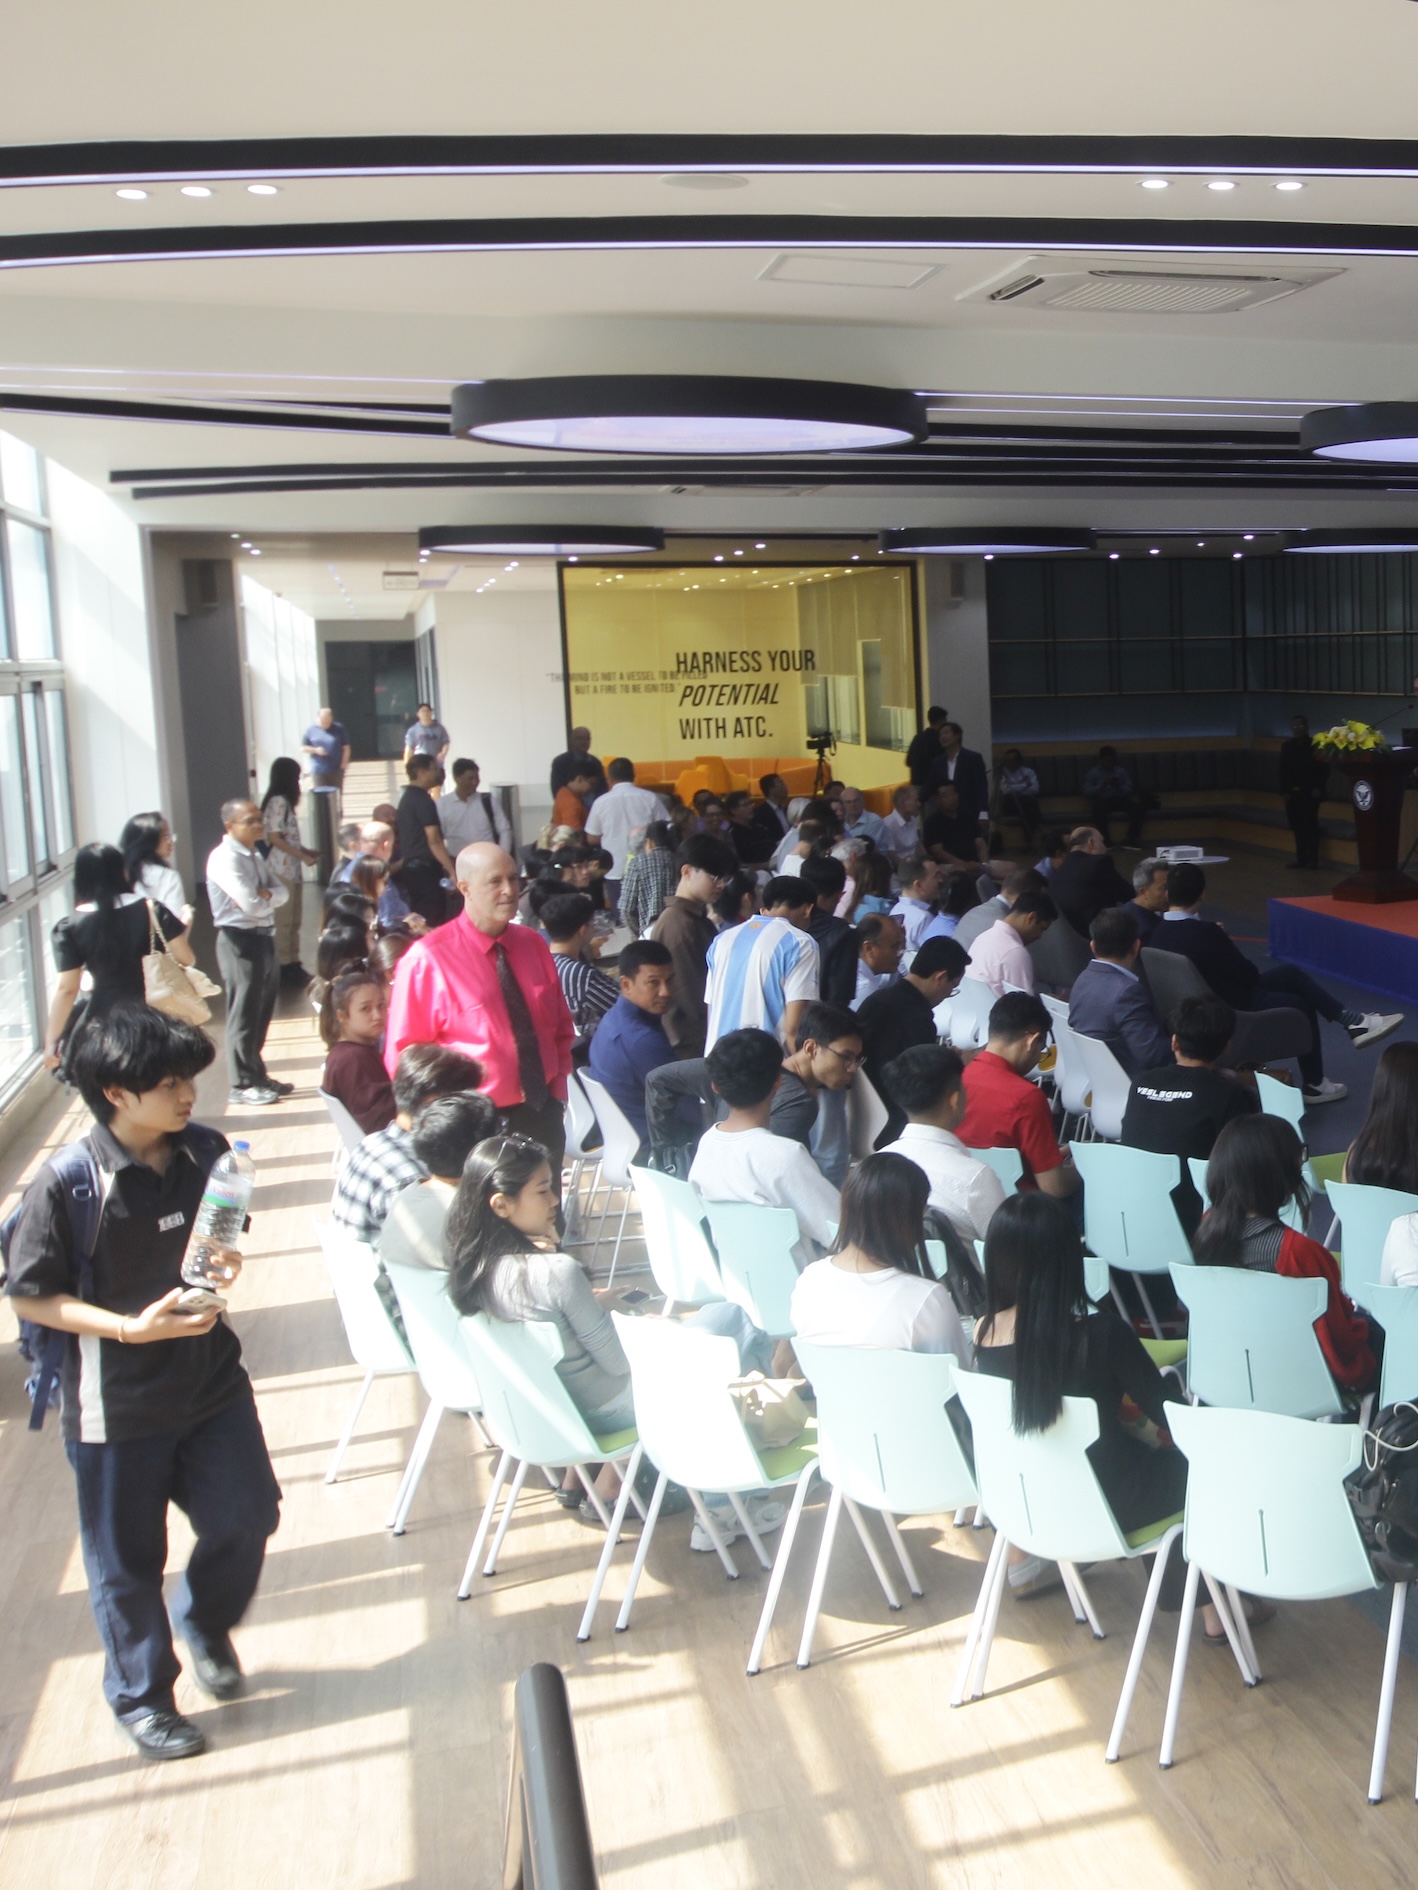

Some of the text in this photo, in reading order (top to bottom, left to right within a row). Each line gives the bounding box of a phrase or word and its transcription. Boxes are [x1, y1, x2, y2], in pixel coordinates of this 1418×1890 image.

[676, 649, 816, 673] HARNESS YOUR
[626, 671, 656, 680] VESSEL
[679, 683, 780, 707] POTENTIAL
[679, 716, 774, 740] WITH ATC.
